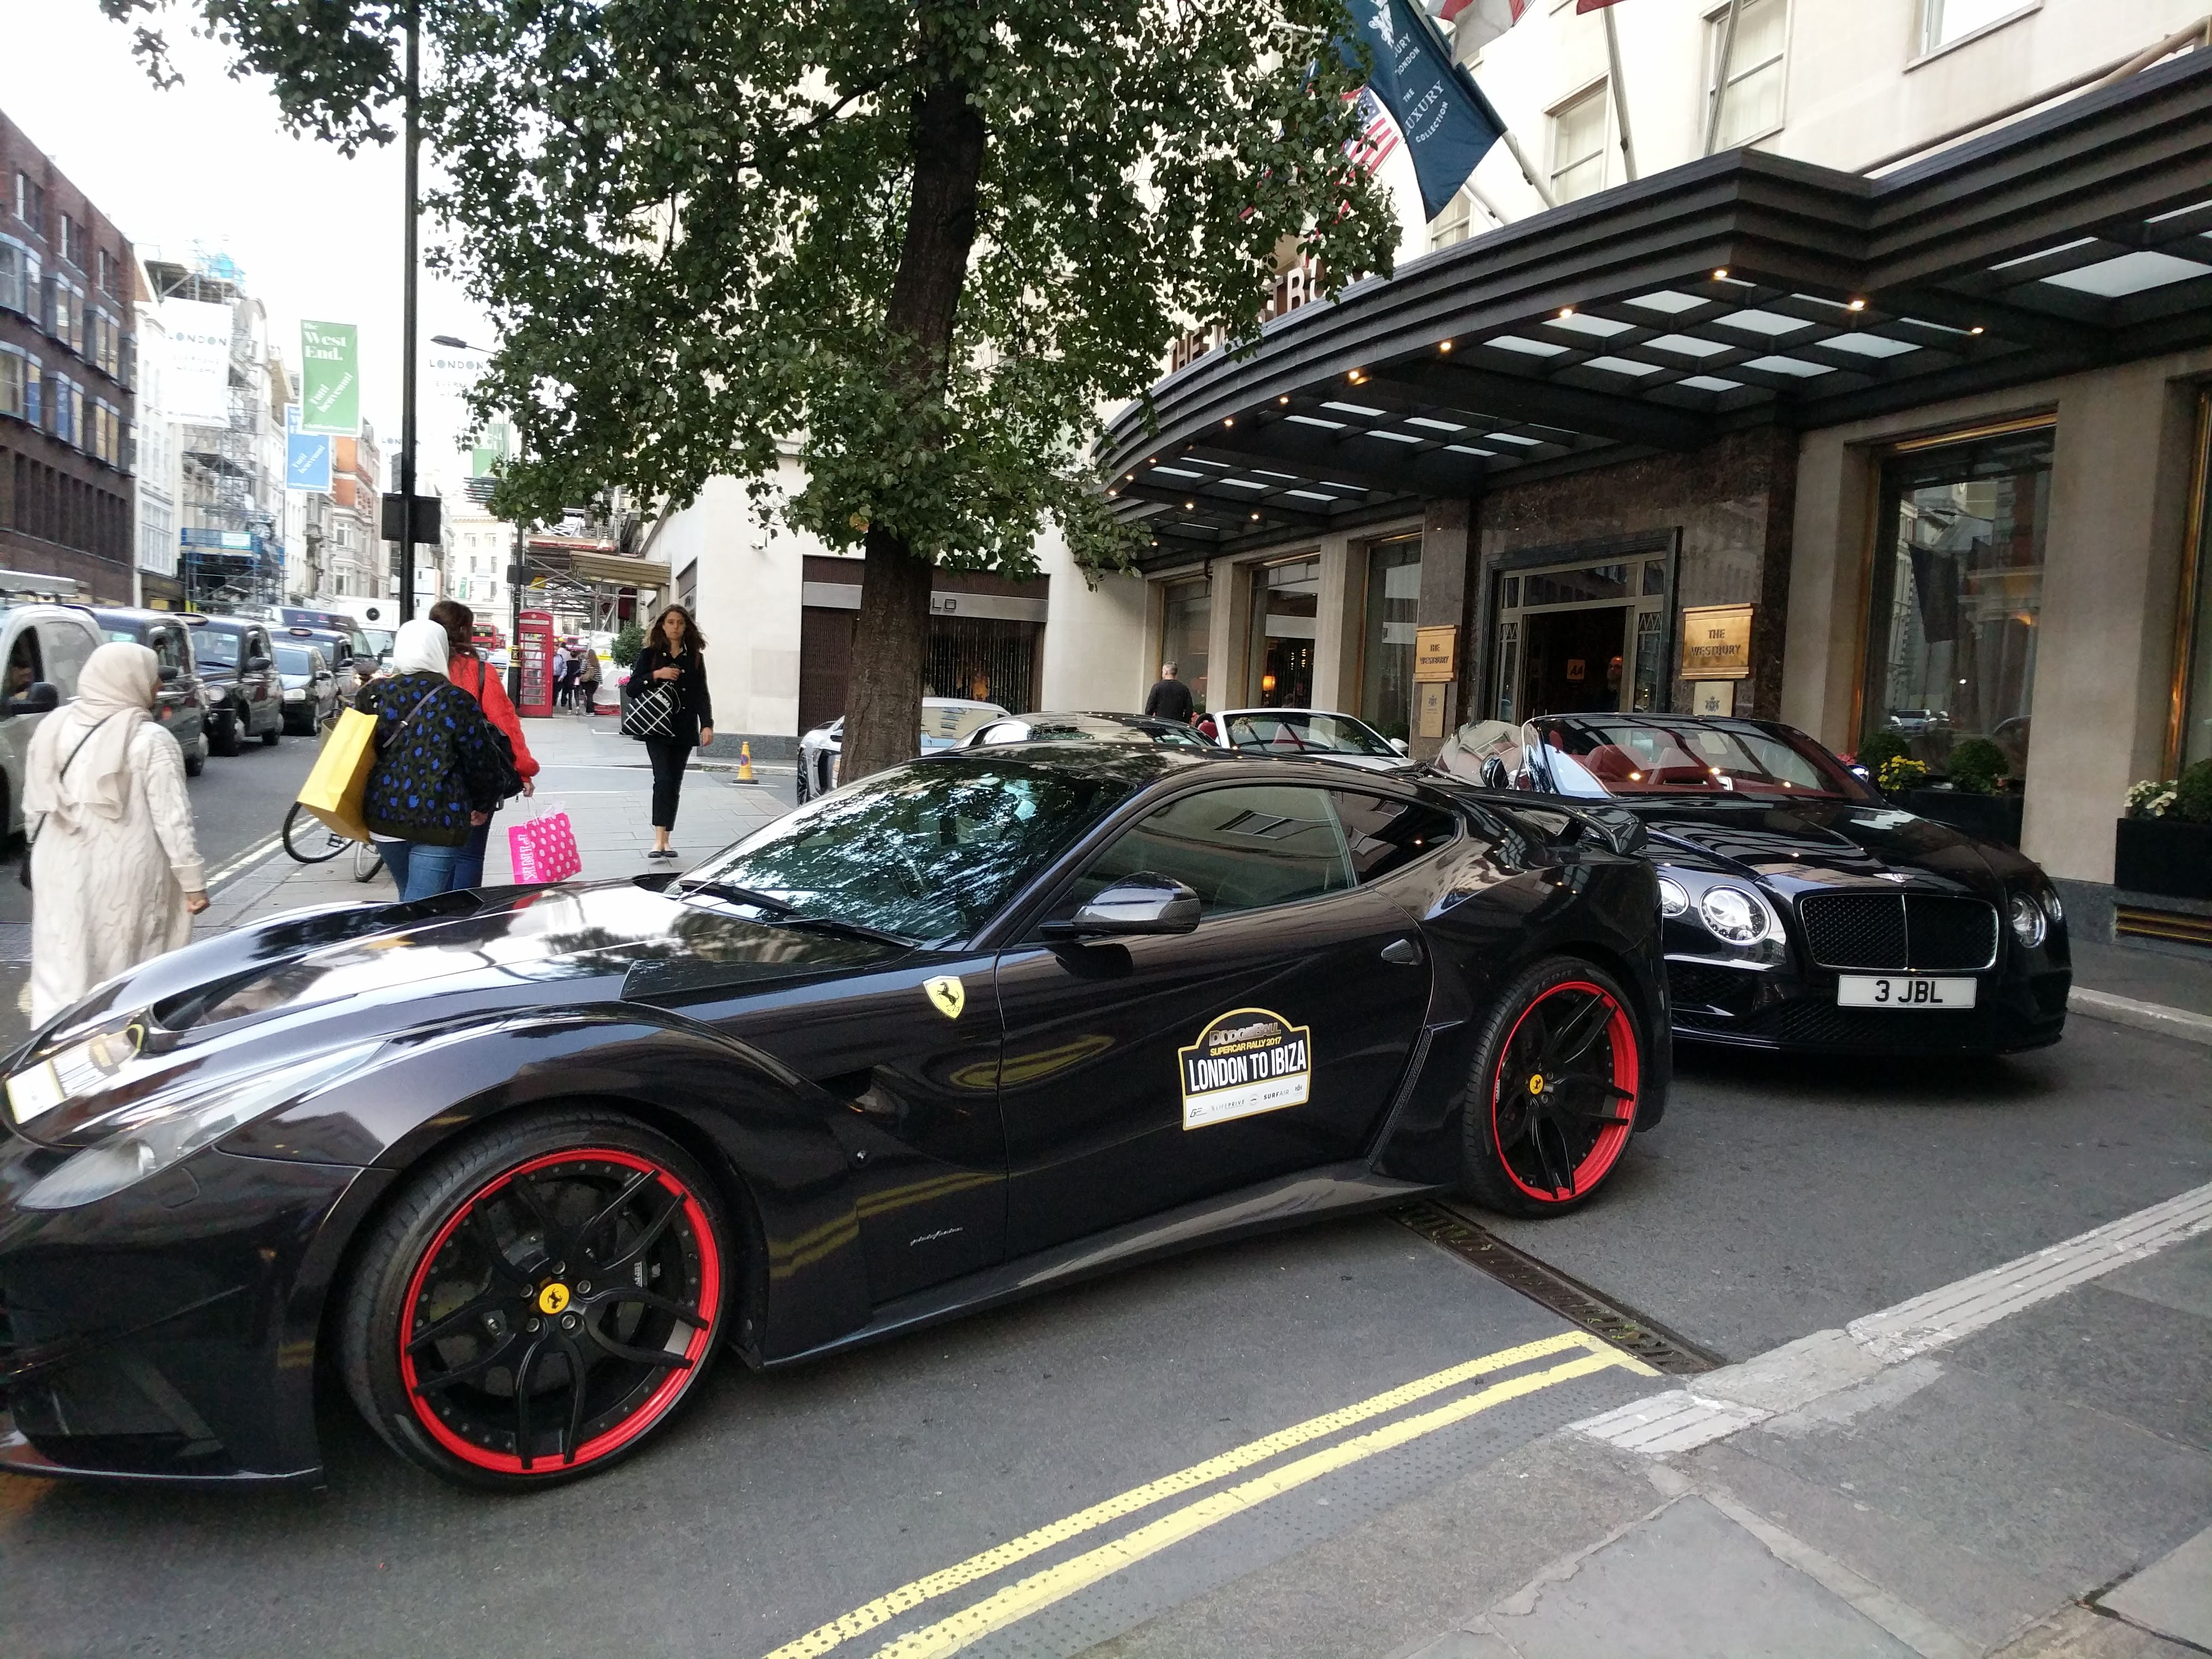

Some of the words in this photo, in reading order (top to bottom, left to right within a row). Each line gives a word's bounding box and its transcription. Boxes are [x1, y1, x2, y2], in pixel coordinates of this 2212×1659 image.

[1402, 87, 1415, 103] THE
[1415, 101, 1449, 143] COLLECTION
[168, 332, 227, 346] LONDON
[304, 331, 346, 346] West
[305, 345, 343, 361] End.
[430, 359, 484, 369] LONDON
[1708, 629, 1726, 639] THE
[1691, 644, 1741, 656] WESTBURY
[1420, 656, 1449, 664] WESTBURY
[517, 834, 538, 880] PINK
[1875, 980, 1890, 1002] 3
[1898, 980, 1943, 1003] JBL
[1210, 1043, 1246, 1056] SUPERCAR
[1246, 1039, 1266, 1050] RALLY
[1266, 1036, 1282, 1048] 2017
[1189, 1055, 1248, 1092] LONDON
[1250, 1051, 1268, 1080] TO
[1271, 1039, 1307, 1076] IBIZA
